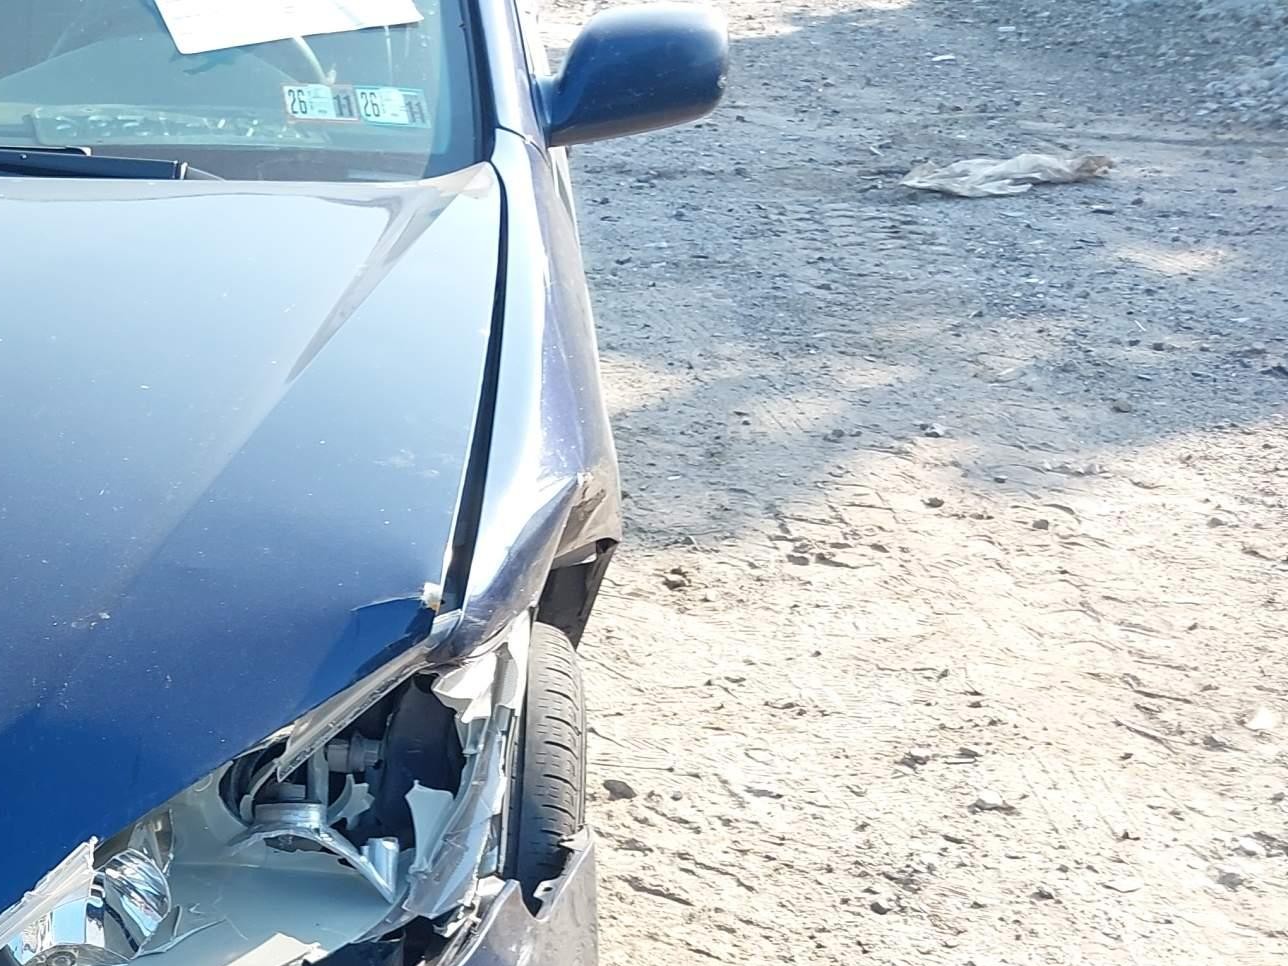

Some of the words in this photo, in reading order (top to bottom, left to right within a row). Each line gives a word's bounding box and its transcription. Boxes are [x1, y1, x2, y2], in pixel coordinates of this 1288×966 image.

[288, 89, 308, 115] 26
[333, 94, 355, 117] 11
[360, 92, 381, 117] 26
[406, 101, 427, 123] 11
